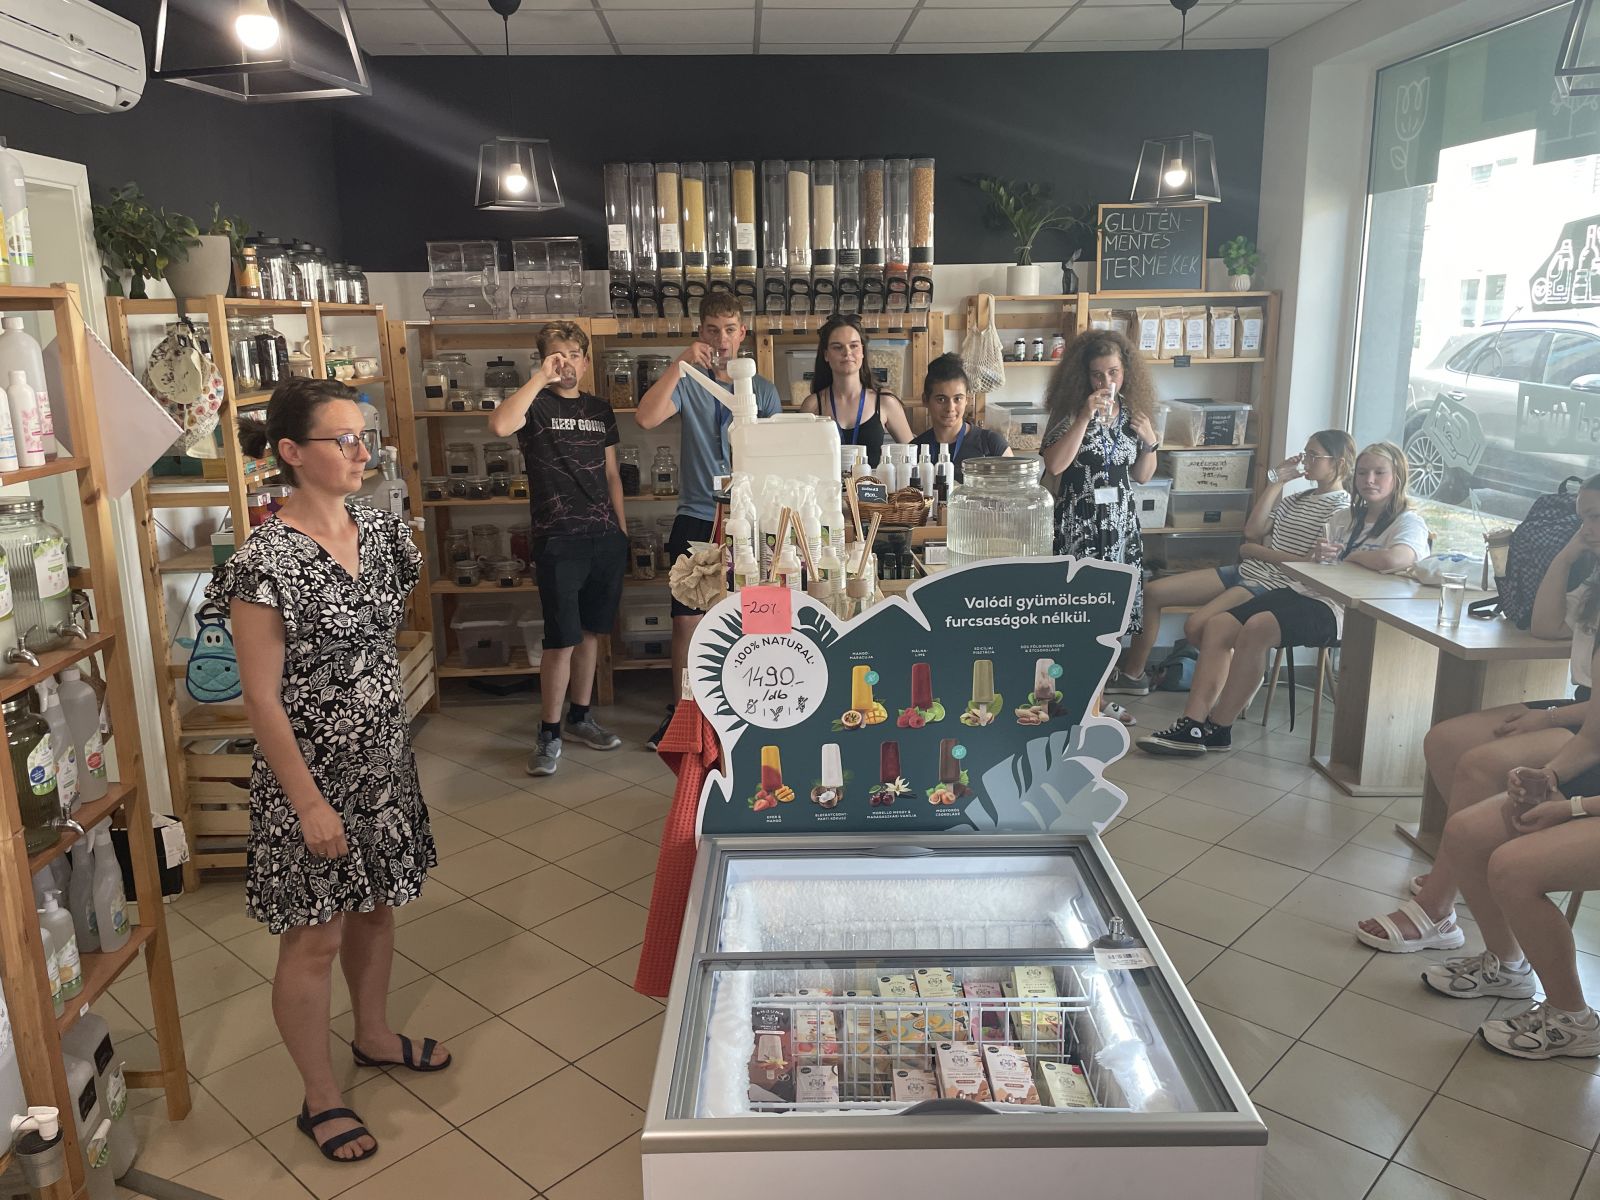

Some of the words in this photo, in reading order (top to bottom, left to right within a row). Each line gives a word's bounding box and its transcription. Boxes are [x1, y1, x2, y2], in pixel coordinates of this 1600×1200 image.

[1104, 233, 1171, 253] MENTES
[551, 417, 577, 431] KEEP
[577, 418, 606, 434] GOING
[964, 595, 1012, 609] Valódi
[1016, 592, 1116, 611] gyümölcsből,
[945, 612, 1038, 629] furcsaságok
[1041, 611, 1091, 625] nélkül.
